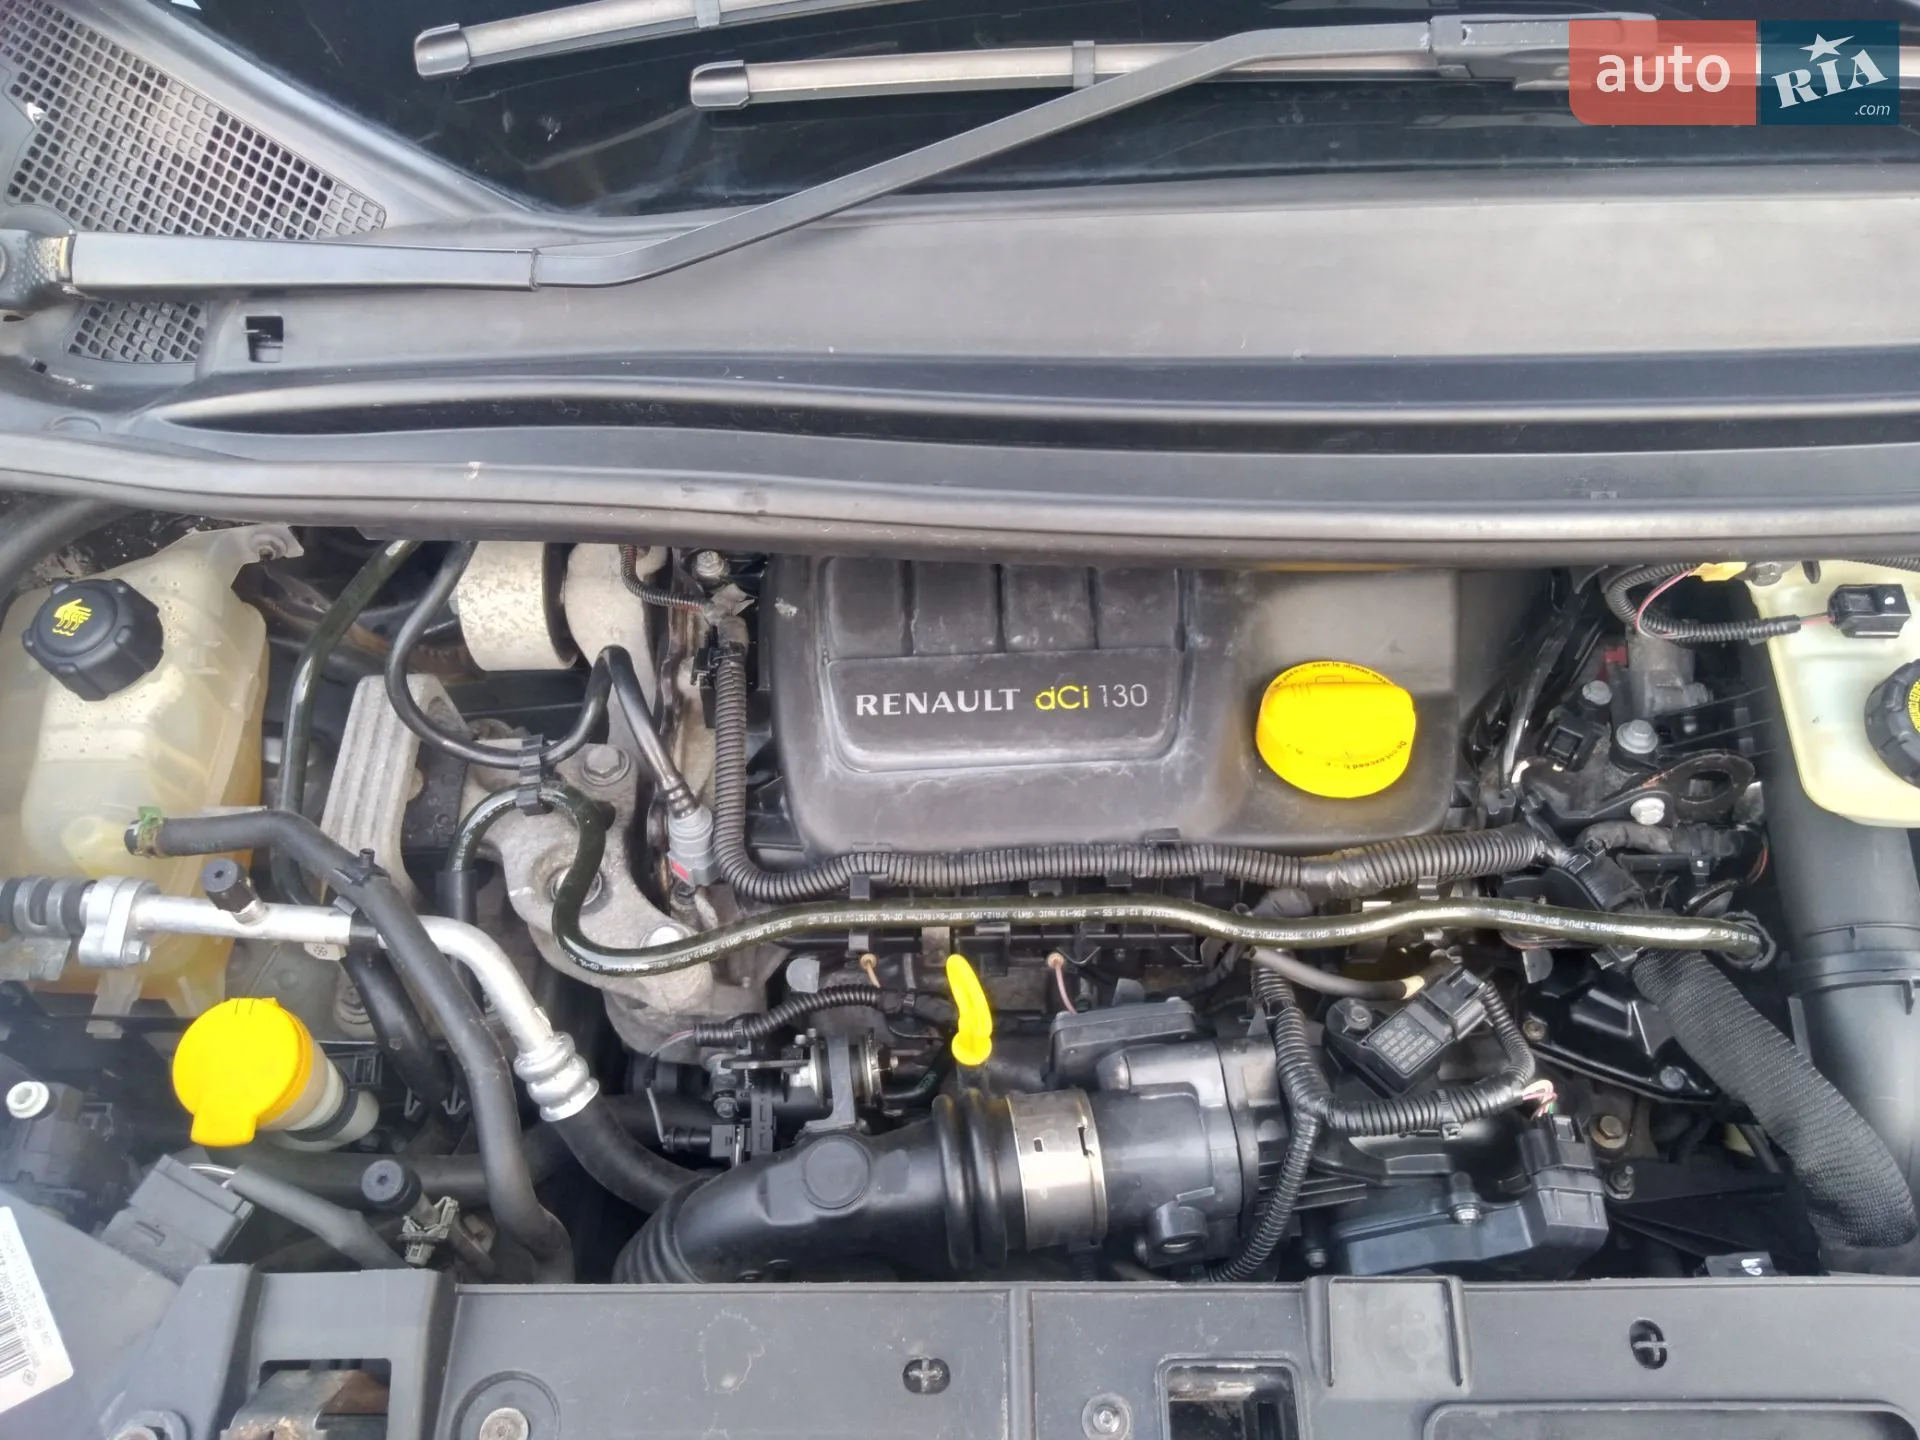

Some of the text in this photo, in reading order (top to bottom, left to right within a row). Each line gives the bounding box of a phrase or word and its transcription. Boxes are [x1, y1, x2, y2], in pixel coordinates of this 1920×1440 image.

[856, 684, 1148, 716] RENAULT dCi 130
